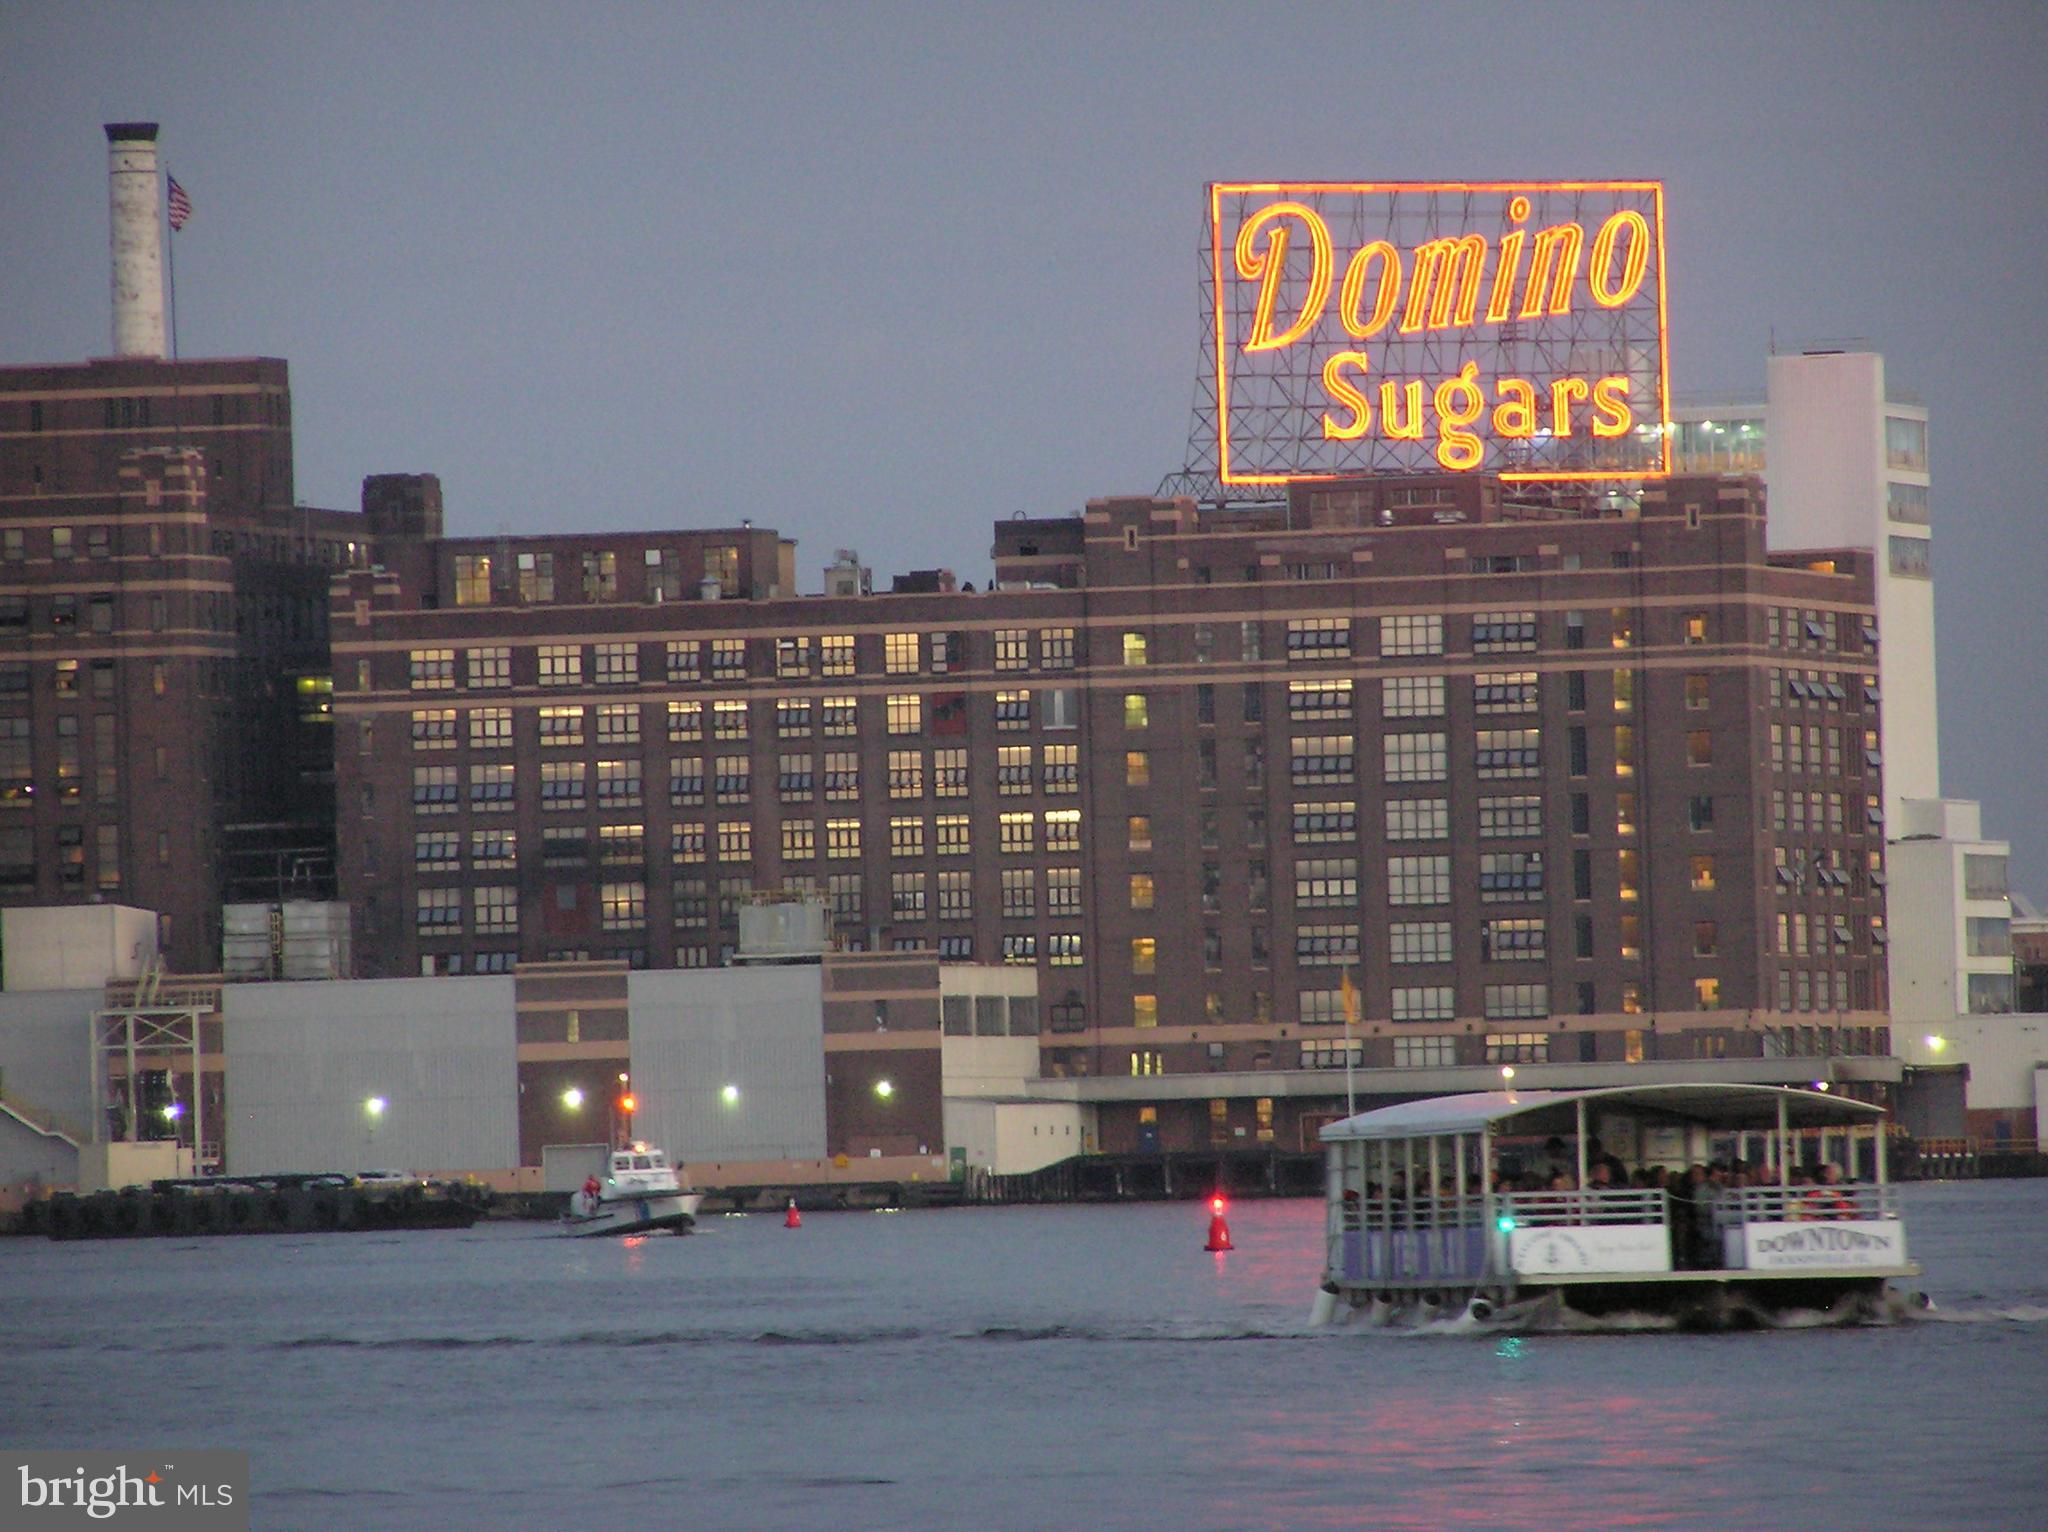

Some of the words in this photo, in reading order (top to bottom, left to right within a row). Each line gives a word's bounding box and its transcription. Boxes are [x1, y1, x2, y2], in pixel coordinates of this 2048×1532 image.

[1234, 195, 1650, 352] Domino
[1322, 351, 1633, 470] Sugars
[1757, 1227, 1890, 1252] DOWNTOWN
